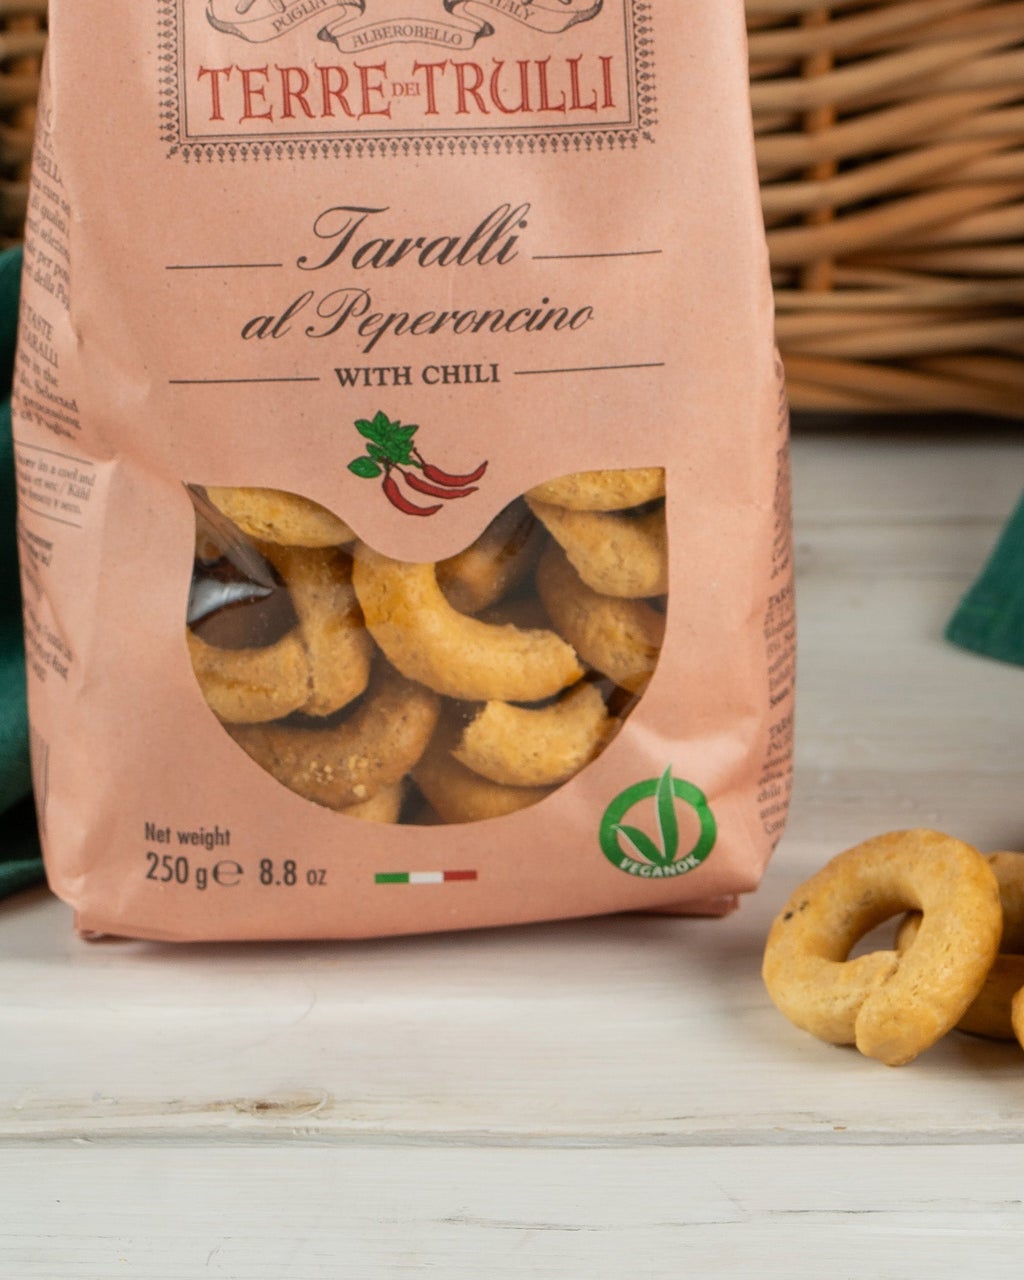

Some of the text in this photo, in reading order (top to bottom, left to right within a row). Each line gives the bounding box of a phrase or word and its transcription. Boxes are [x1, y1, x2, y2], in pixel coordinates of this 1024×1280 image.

[352, 23, 463, 48] ALBEROBELLO
[197, 54, 617, 124] TERRE DEI TRULLI
[296, 202, 532, 272] Taralli
[241, 287, 595, 354] al Peperoncino
[334, 363, 502, 388] WITH CHILI
[144, 821, 231, 851] Net weight
[258, 858, 298, 887] 8.8
[306, 868, 328, 887] oz
[620, 853, 701, 878] VEGANOK
